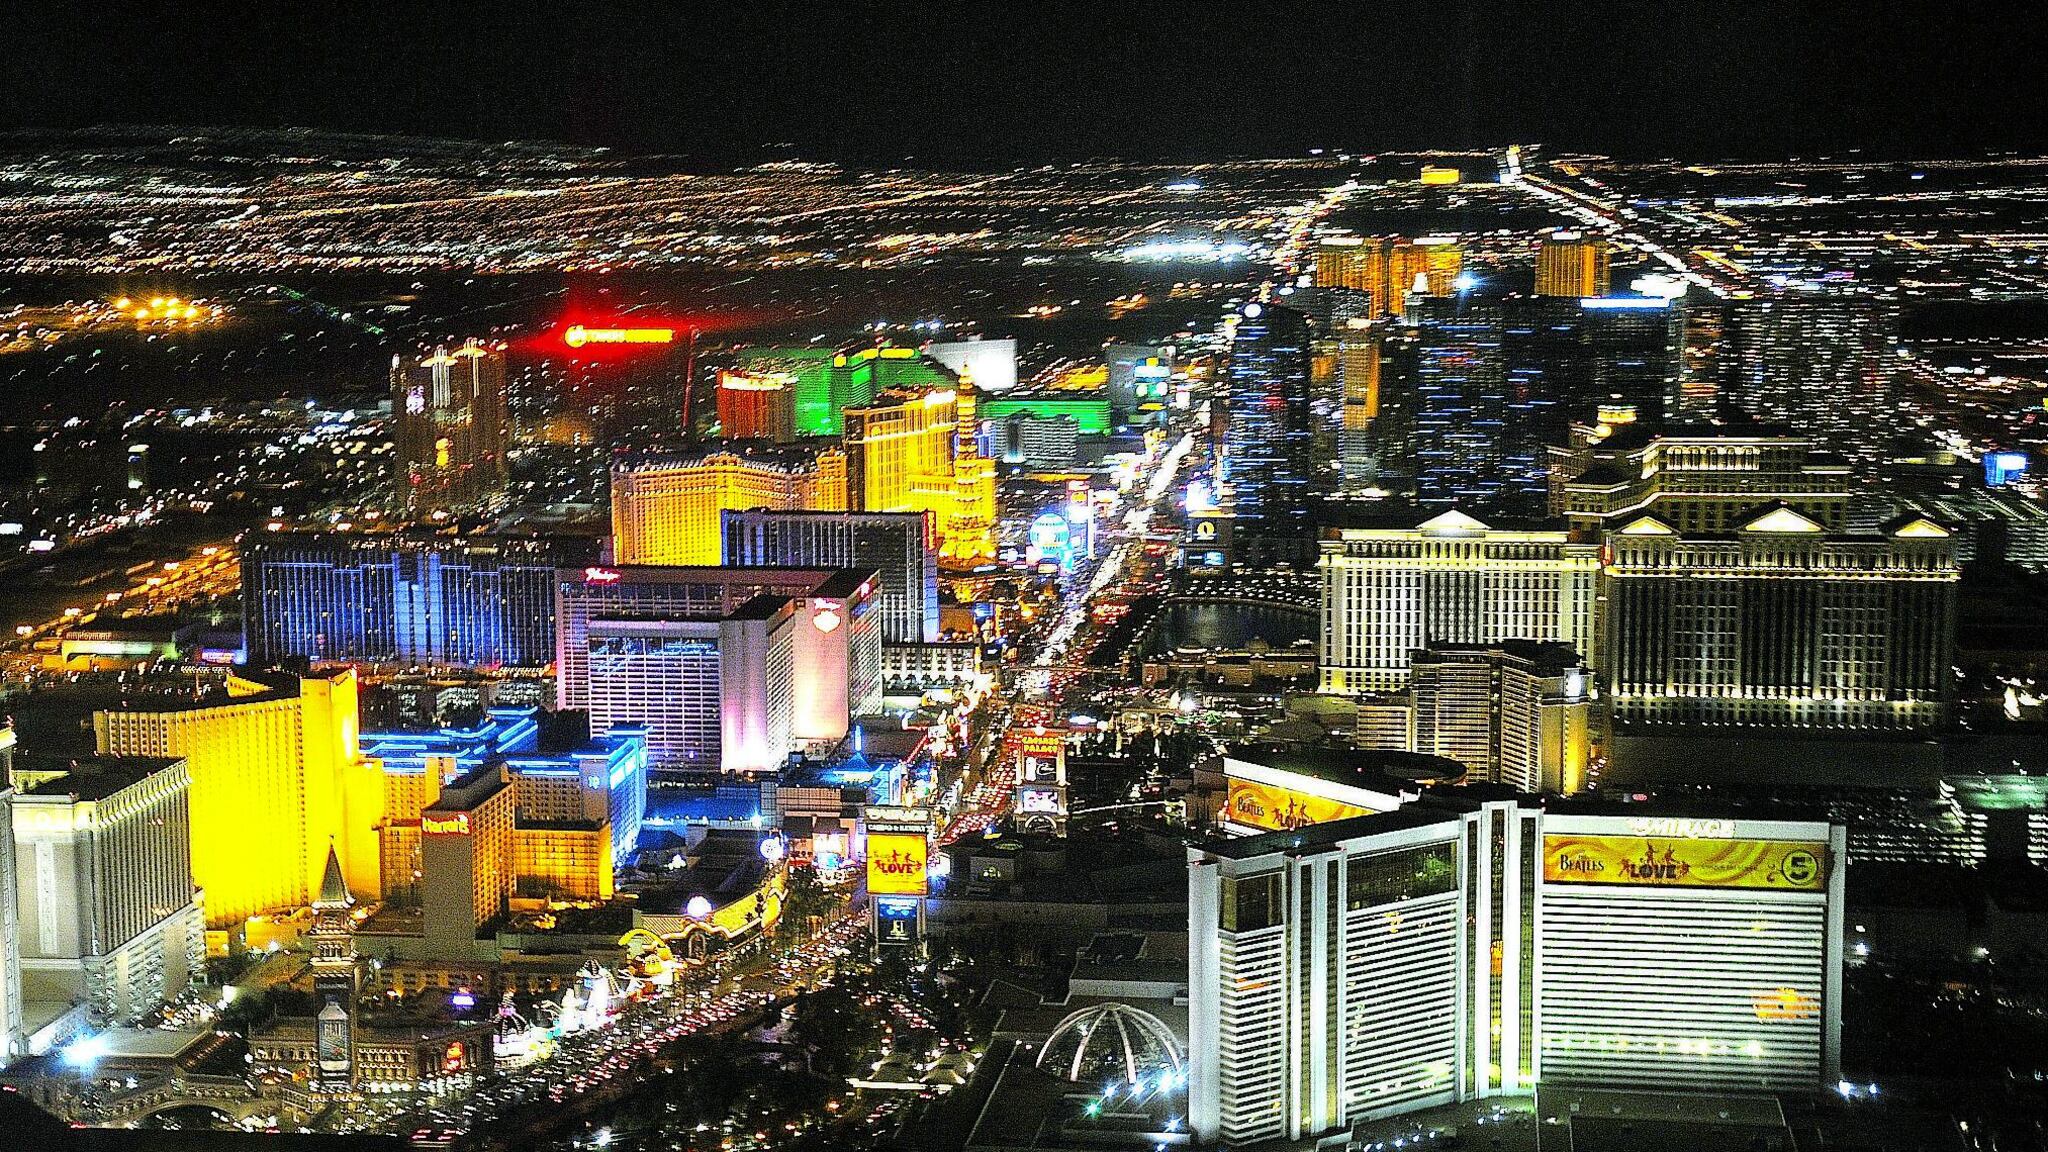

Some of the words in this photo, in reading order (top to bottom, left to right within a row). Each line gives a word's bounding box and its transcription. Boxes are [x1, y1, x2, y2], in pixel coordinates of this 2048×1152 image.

[881, 862, 913, 874] LOVE
[1560, 854, 1604, 873] BEATLES
[1630, 864, 1677, 879] LOVE
[1790, 856, 1809, 880] 5
